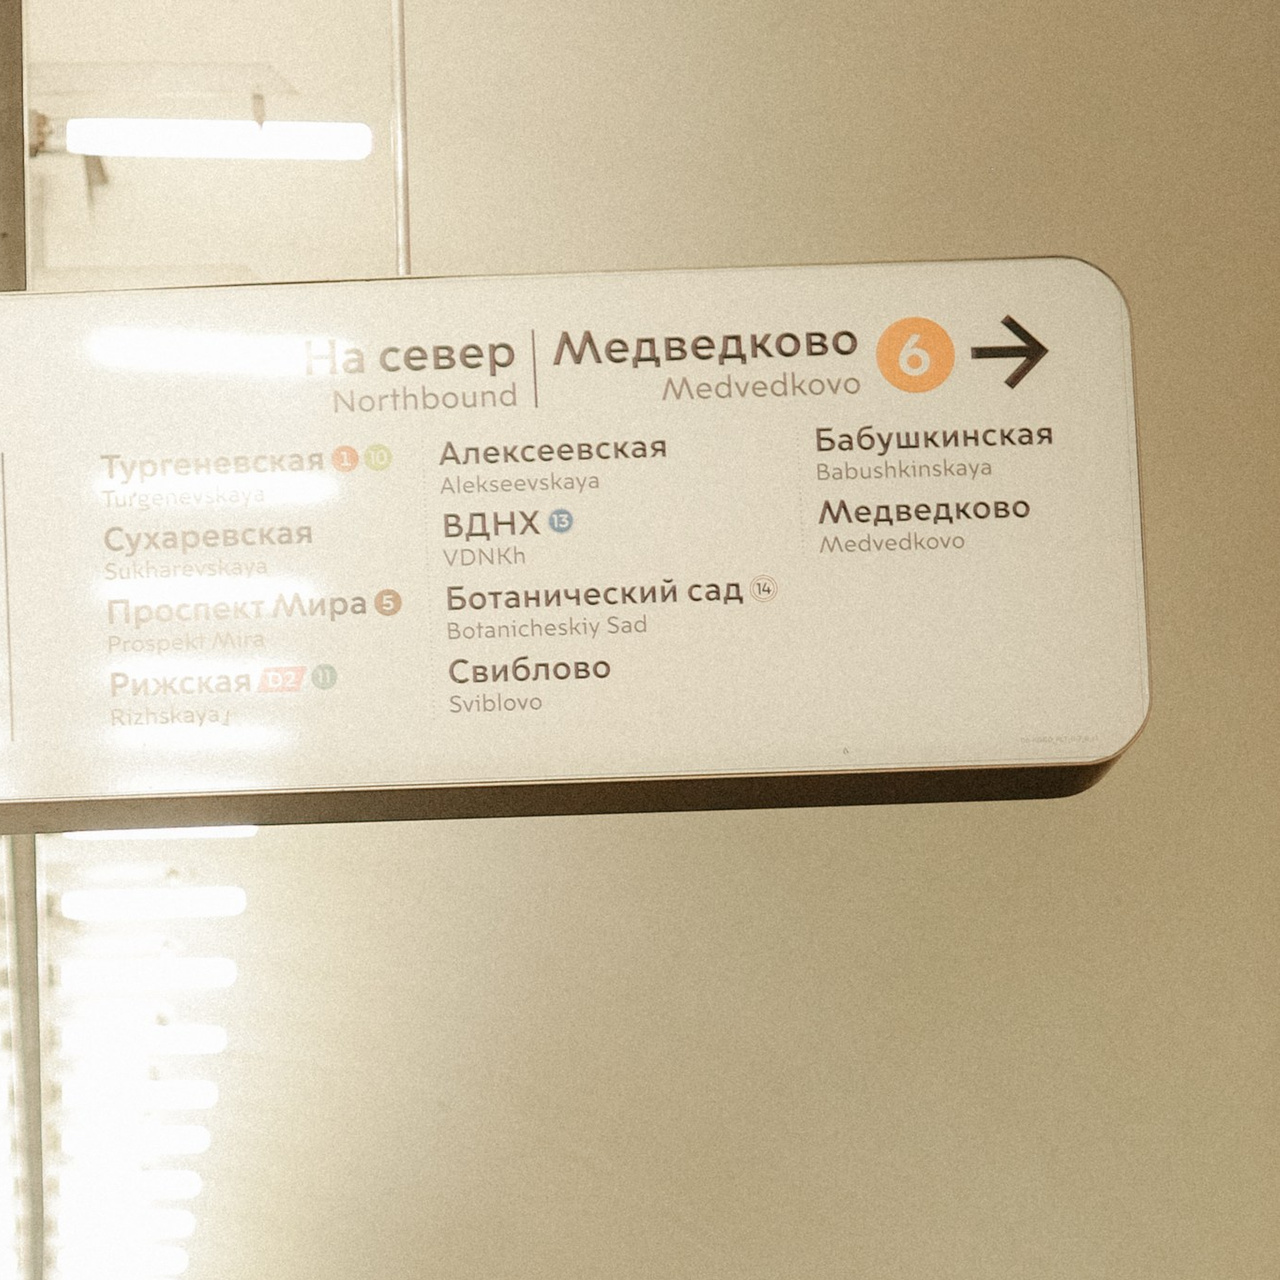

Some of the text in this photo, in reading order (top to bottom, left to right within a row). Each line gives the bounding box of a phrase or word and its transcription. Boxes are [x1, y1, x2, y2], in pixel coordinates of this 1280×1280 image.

[305, 339, 516, 376] На север
[553, 328, 858, 368] Медведково
[899, 334, 930, 377] 6
[333, 383, 518, 413] Northbound
[662, 372, 861, 402] Medvedkovo
[439, 436, 667, 466] Алексеевская
[815, 424, 1053, 457] Бабушкинская
[101, 452, 324, 484] Тургеневская
[816, 458, 993, 482] Babushkinskaya
[440, 472, 600, 497] Alekseevskaya
[443, 510, 541, 541] ВДНХ
[818, 497, 1031, 527] Медведково
[103, 525, 313, 556] Сухаревская
[820, 530, 964, 554] Medvedkovo
[104, 559, 268, 581] Sukharevskaya
[443, 545, 526, 567] VDNKh
[446, 578, 678, 611] Ботанический
[687, 578, 743, 605] сад
[107, 598, 265, 629] Проспект
[273, 593, 366, 621] Мира
[108, 631, 265, 654] Prospekt Mira
[447, 615, 647, 641] Botanicheskiy Sad
[110, 672, 252, 697] Рижская
[448, 655, 611, 685] Свиблово
[111, 708, 220, 727] Rizhskaya
[449, 692, 542, 714] Sviblovo
